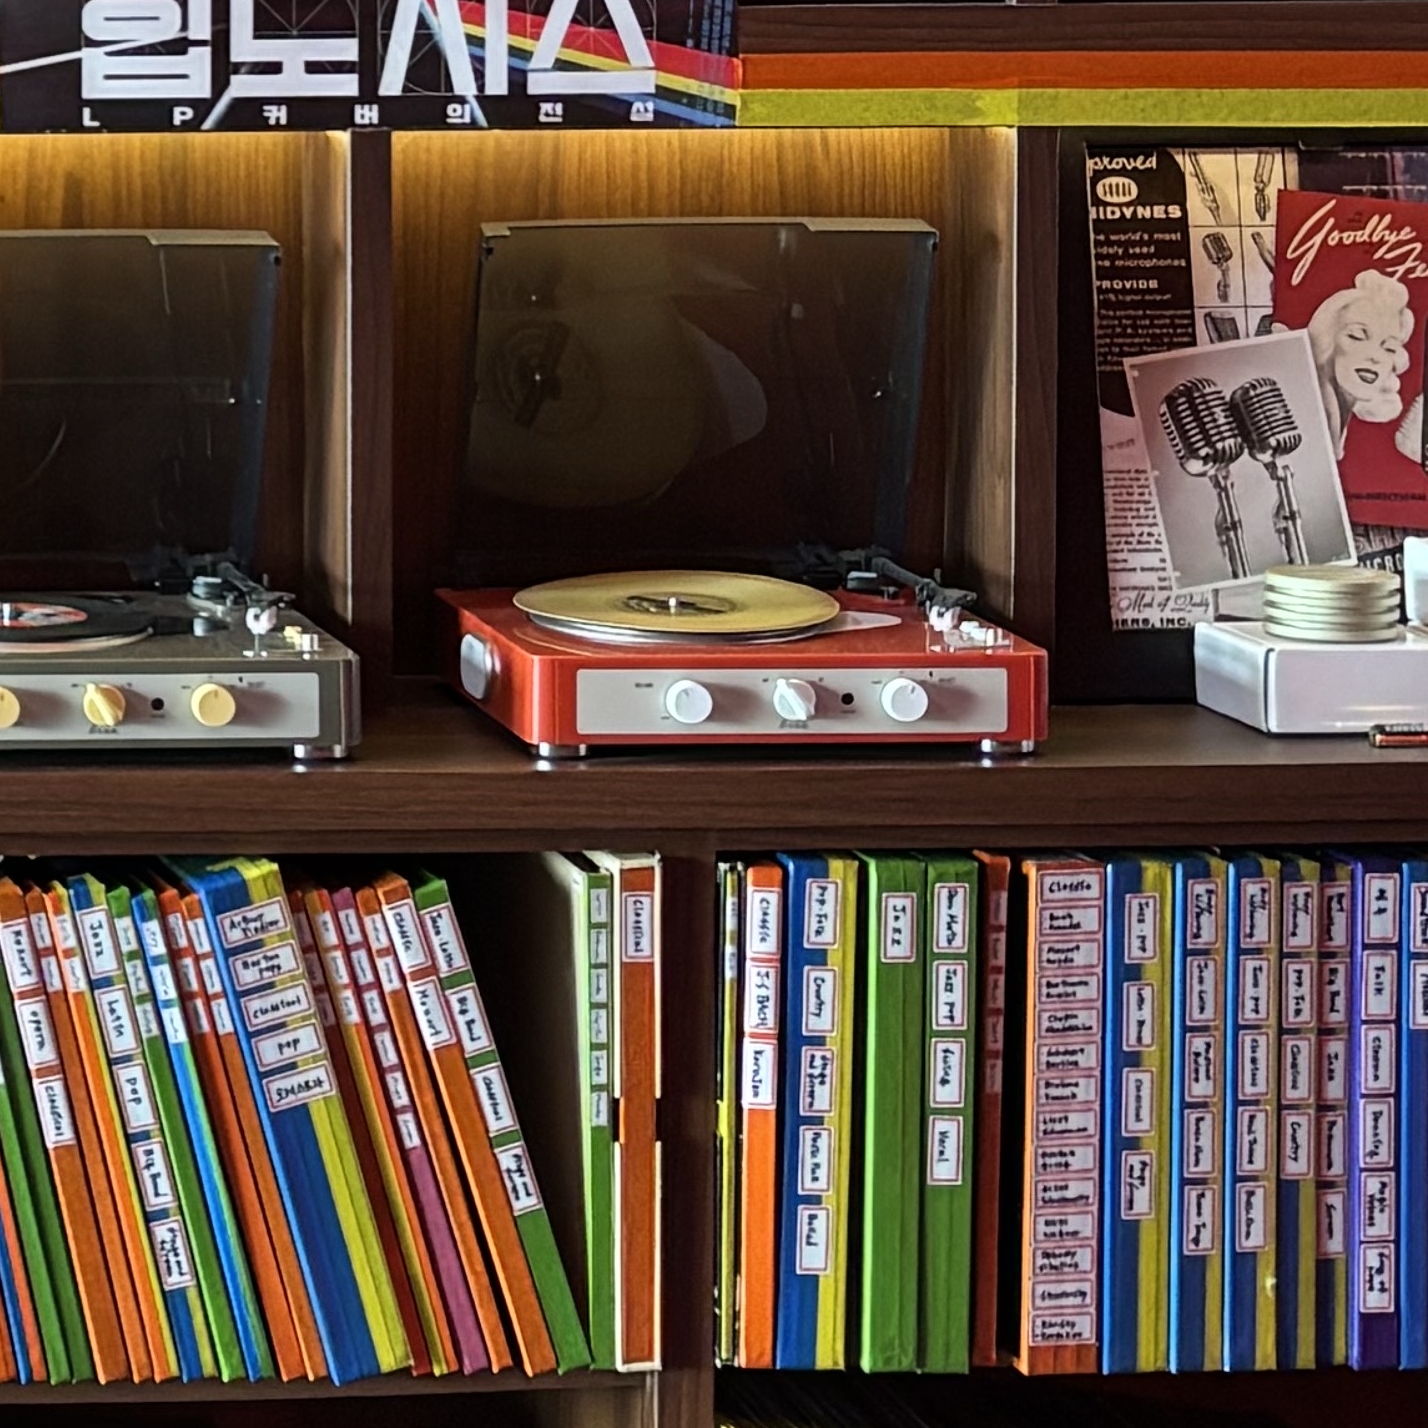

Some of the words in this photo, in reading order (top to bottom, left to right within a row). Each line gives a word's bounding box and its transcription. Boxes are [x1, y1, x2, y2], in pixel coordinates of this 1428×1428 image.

[1154, 233, 1181, 241] most
[1287, 199, 1414, 286] Goodbye
[1115, 258, 1186, 268] microphones
[1160, 618, 1192, 627] INC.
